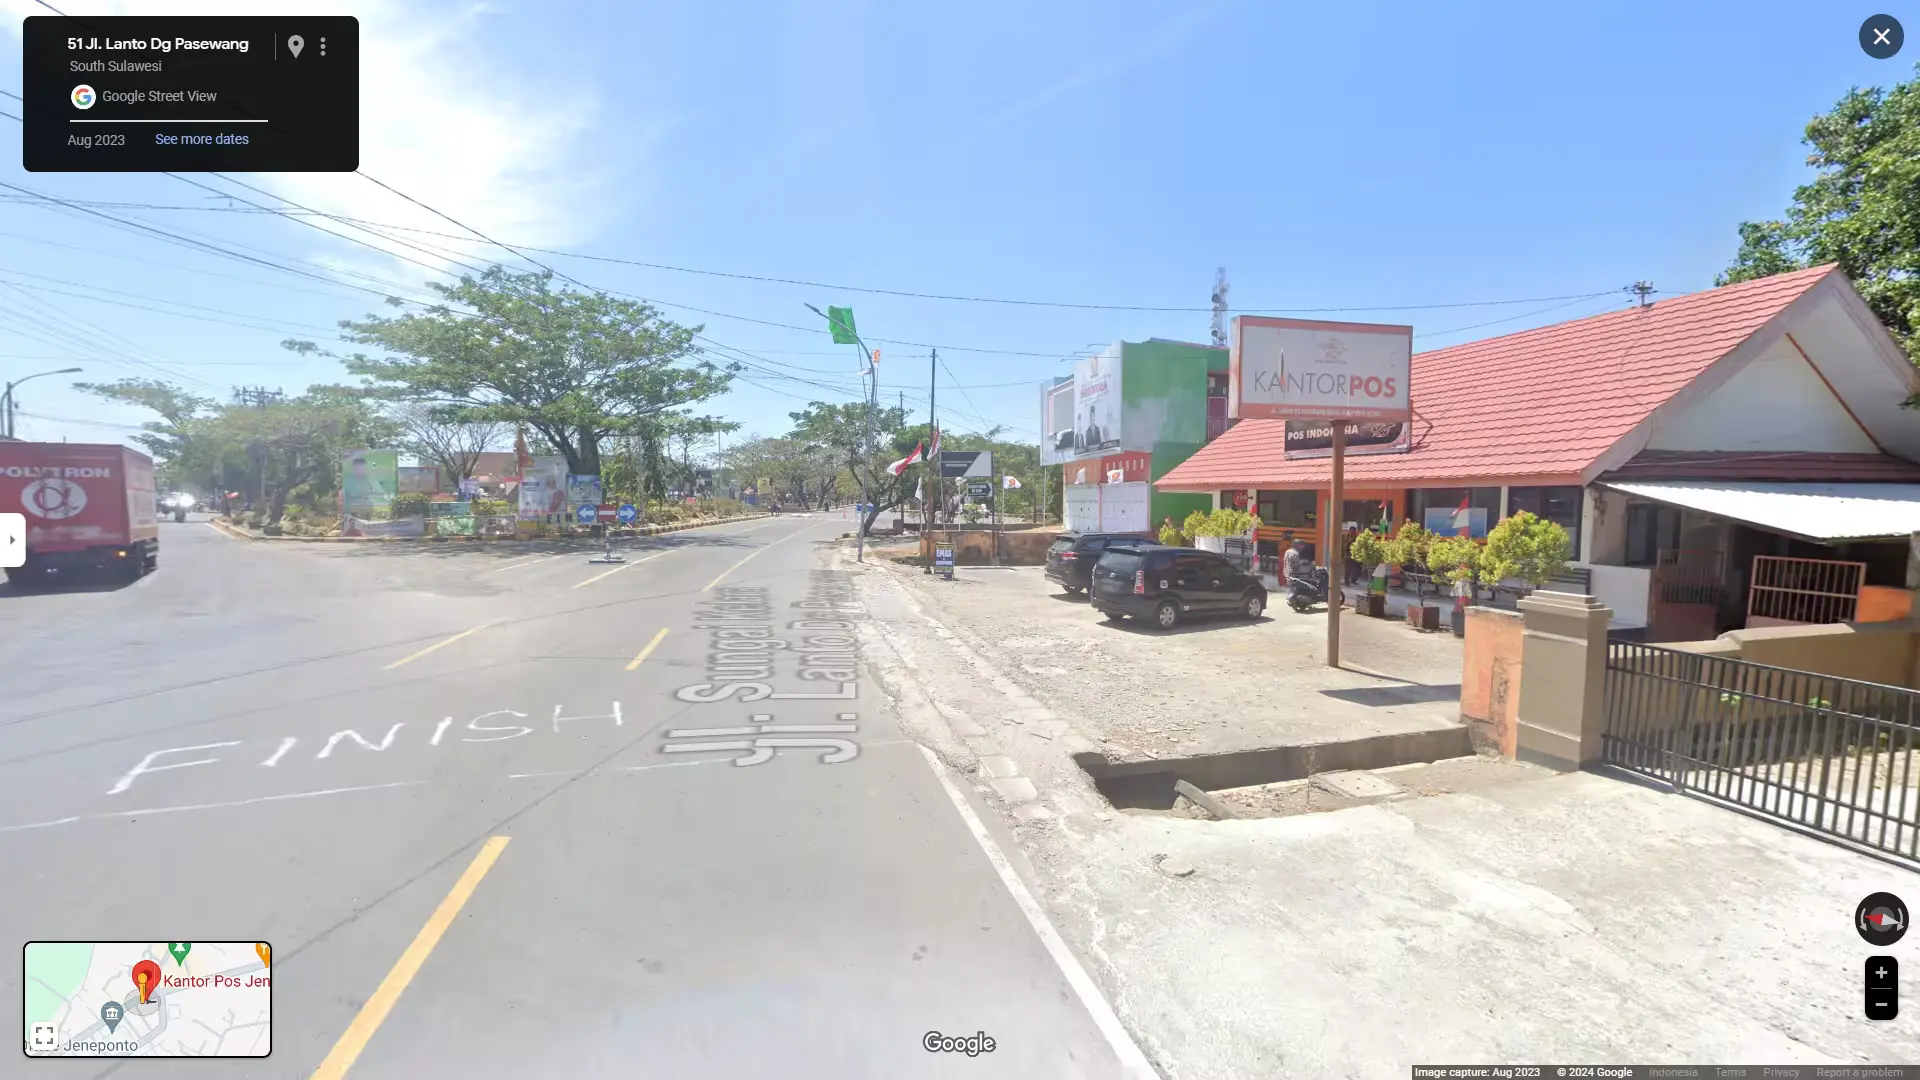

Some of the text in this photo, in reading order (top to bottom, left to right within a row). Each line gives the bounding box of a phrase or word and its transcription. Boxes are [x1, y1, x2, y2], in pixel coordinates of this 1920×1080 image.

[1287, 424, 1359, 441] POS INDOSIA
[106, 700, 626, 796] FINISH
